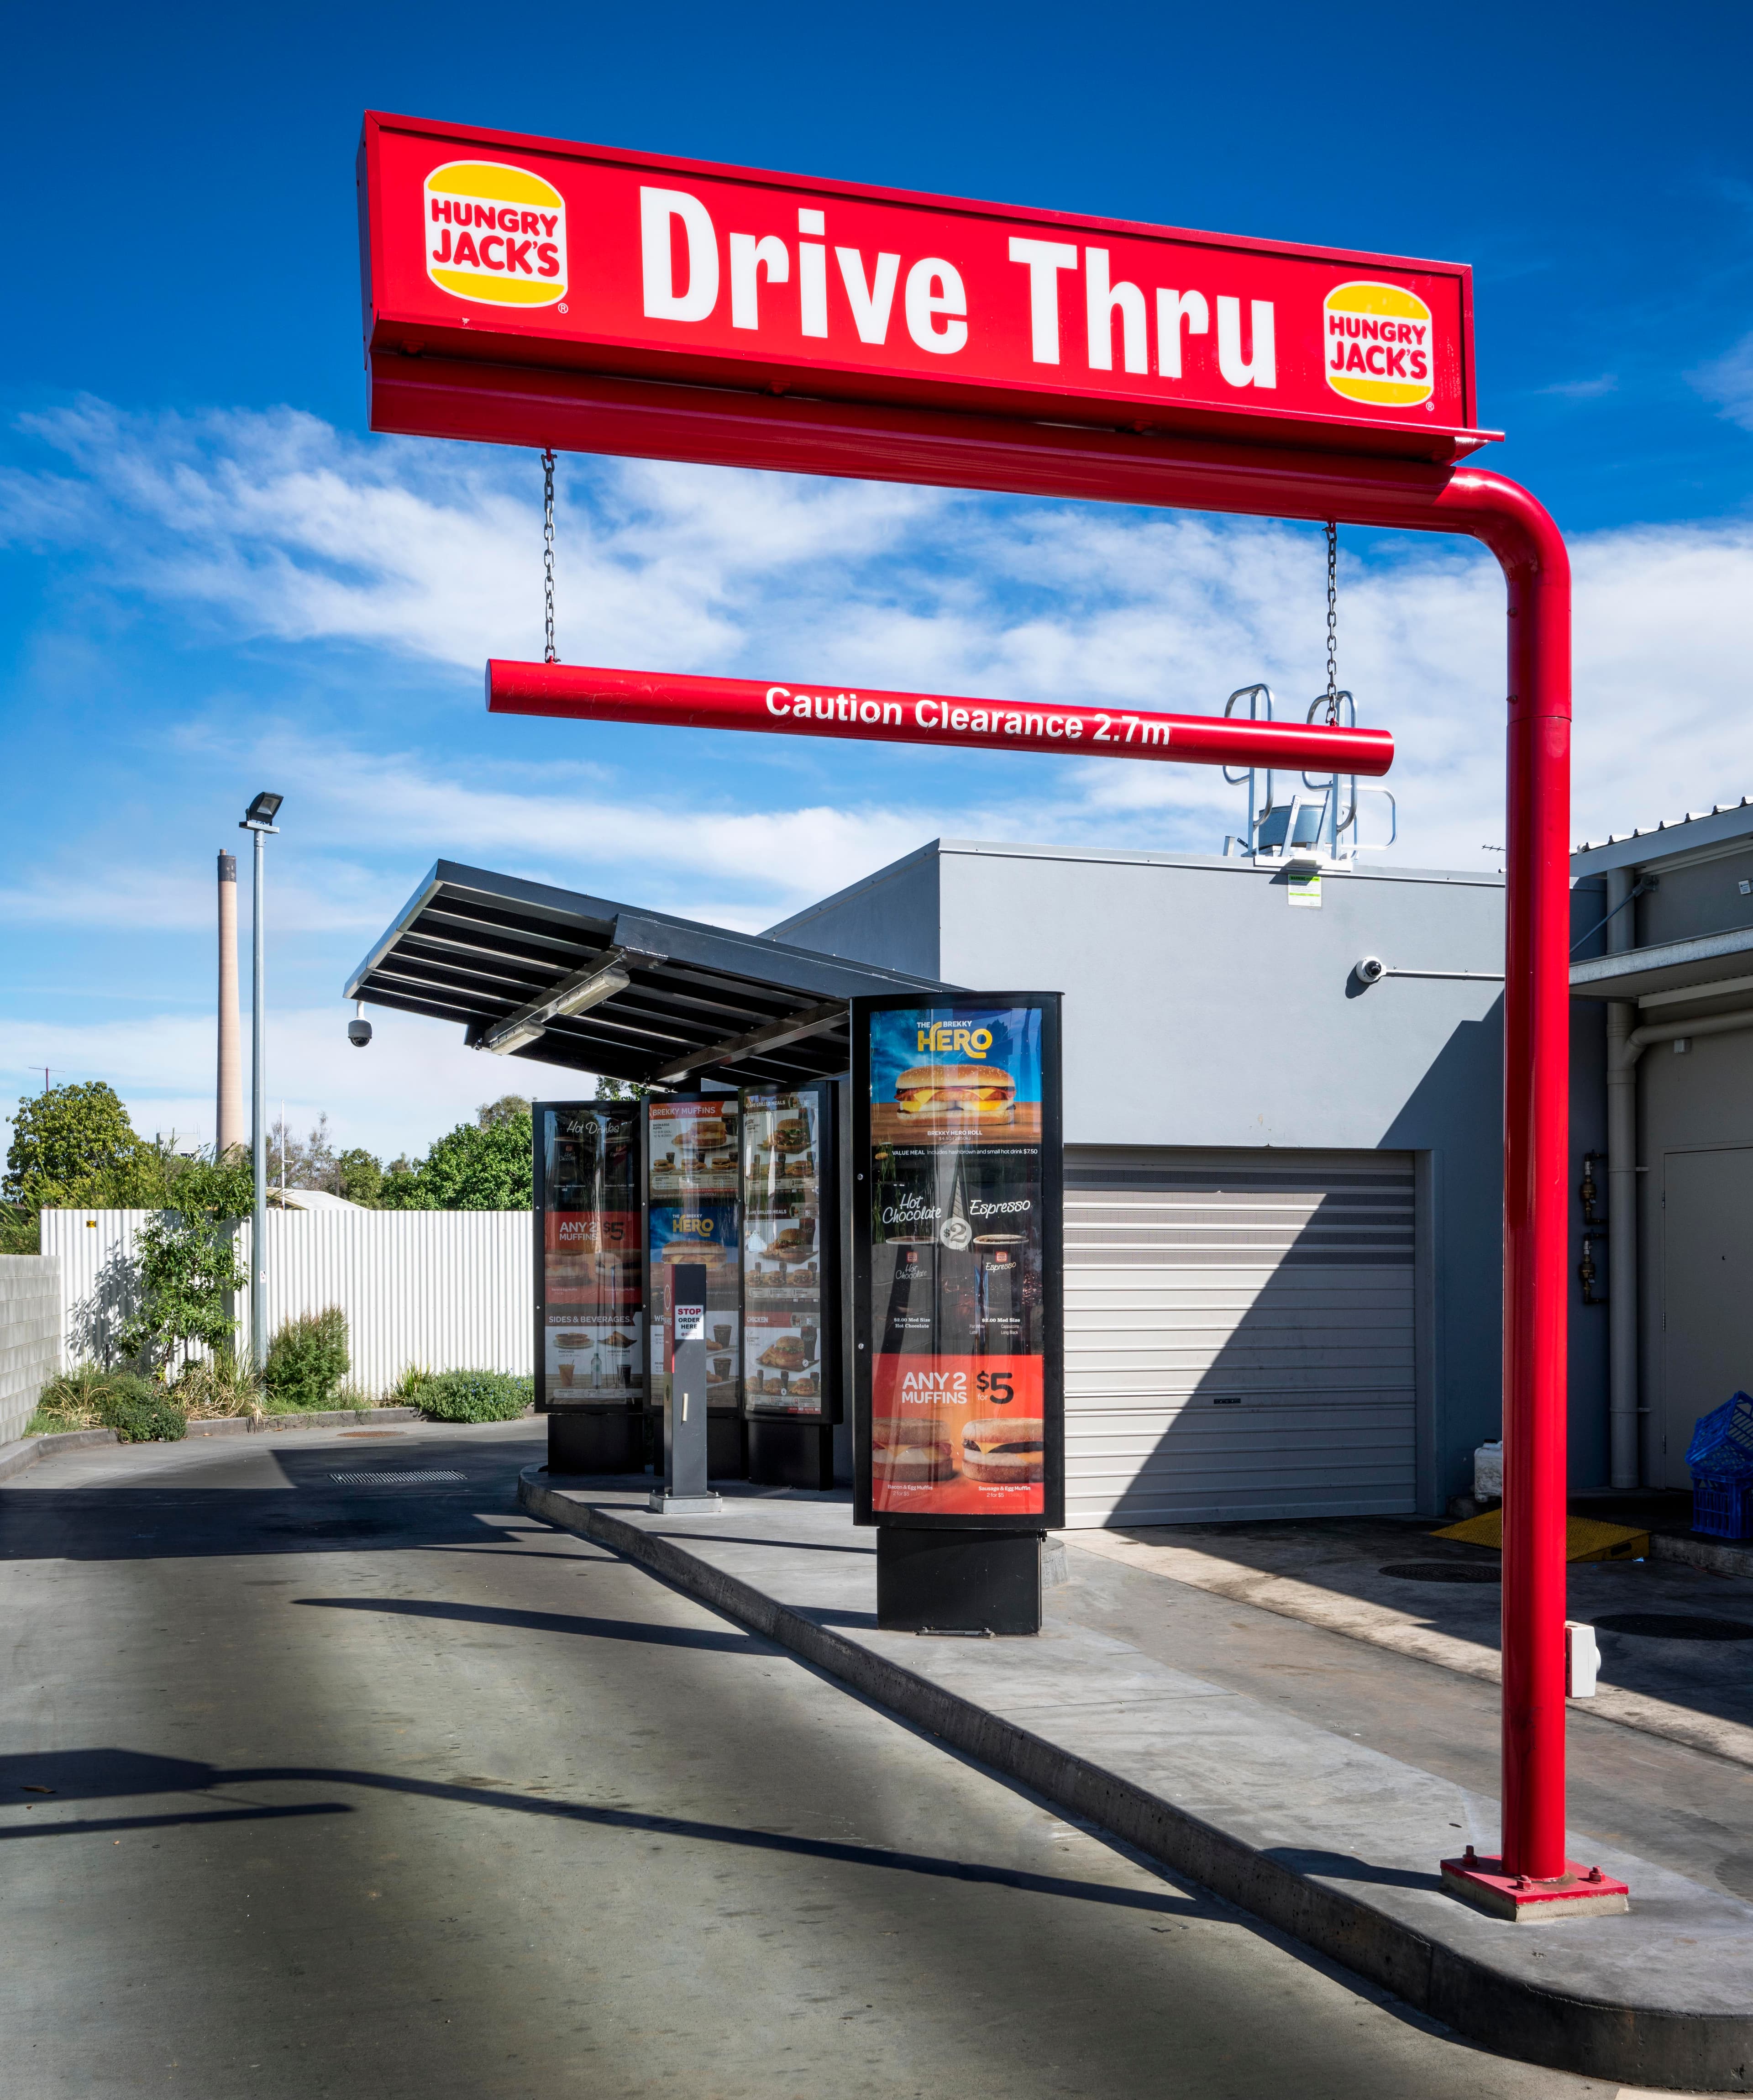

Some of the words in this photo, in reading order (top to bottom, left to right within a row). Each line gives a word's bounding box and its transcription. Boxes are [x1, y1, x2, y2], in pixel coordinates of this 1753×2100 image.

[431, 198, 558, 238] HUNGRY
[432, 229, 560, 278] JACK'S
[640, 186, 968, 354] Drive
[1009, 237, 1276, 389] Thru
[1329, 315, 1427, 346] HUNGRY
[1330, 341, 1428, 380] JACK'S
[766, 687, 902, 725] Caution
[915, 700, 1083, 739] Clearance
[1093, 714, 1170, 745] 2.7m
[917, 1022, 992, 1058] HERO
[653, 1108, 680, 1116] BREKKY
[567, 1121, 584, 1133] Hot
[586, 1122, 619, 1134] Drinks
[900, 1192, 924, 1209] Hot
[969, 1199, 1030, 1218] Espresso
[882, 1205, 941, 1224] Chocolate
[560, 1221, 587, 1232] ANY
[589, 1221, 597, 1232] 2
[604, 1221, 625, 1241] $5
[673, 1214, 714, 1237] HERO
[943, 1222, 967, 1244] $2
[896, 1269, 927, 1279] Chocolate
[905, 1264, 918, 1273] Hot
[986, 1262, 1016, 1273] Espresso
[902, 1372, 950, 1390] ANY
[953, 1372, 967, 1390] 2
[976, 1370, 1014, 1404] $5
[902, 1391, 967, 1404] MUFFINS
